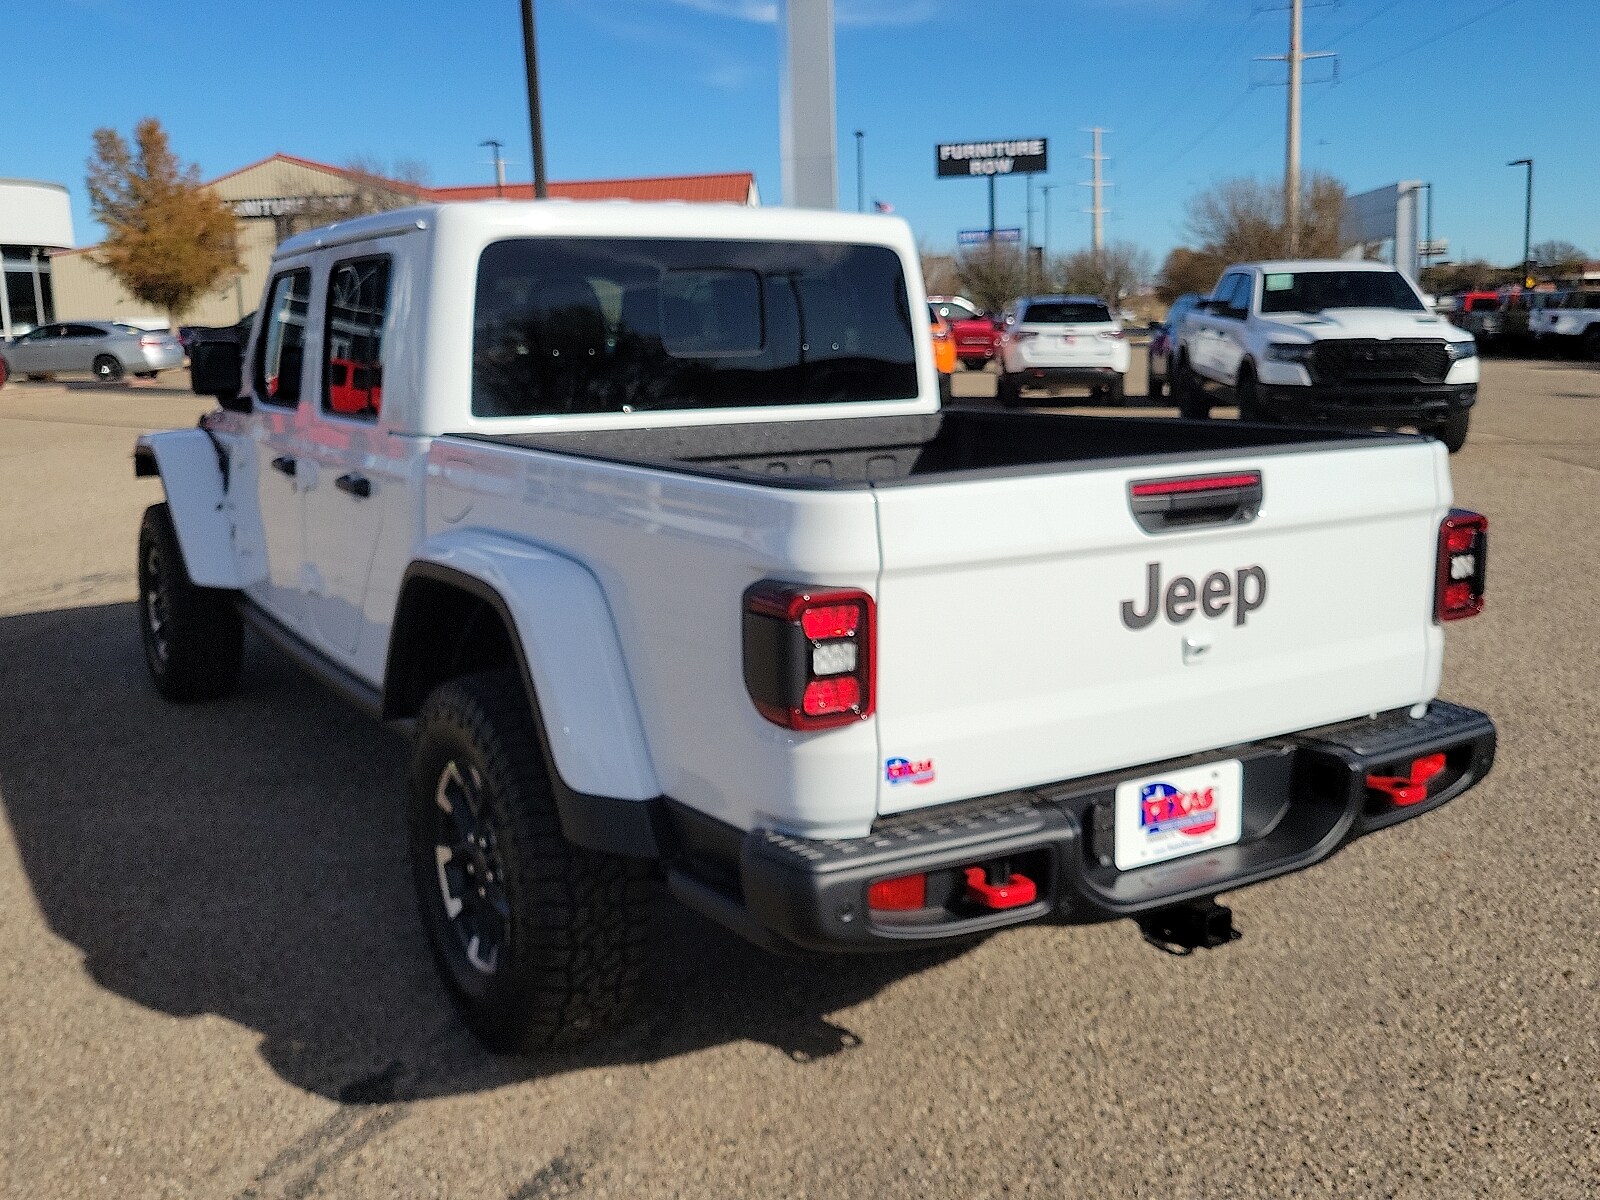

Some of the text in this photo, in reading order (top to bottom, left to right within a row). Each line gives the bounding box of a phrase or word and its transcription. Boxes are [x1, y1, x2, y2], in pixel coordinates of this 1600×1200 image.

[940, 140, 1045, 160] FURNITURE
[969, 157, 1015, 175] ROW
[1121, 562, 1267, 631] Jeep
